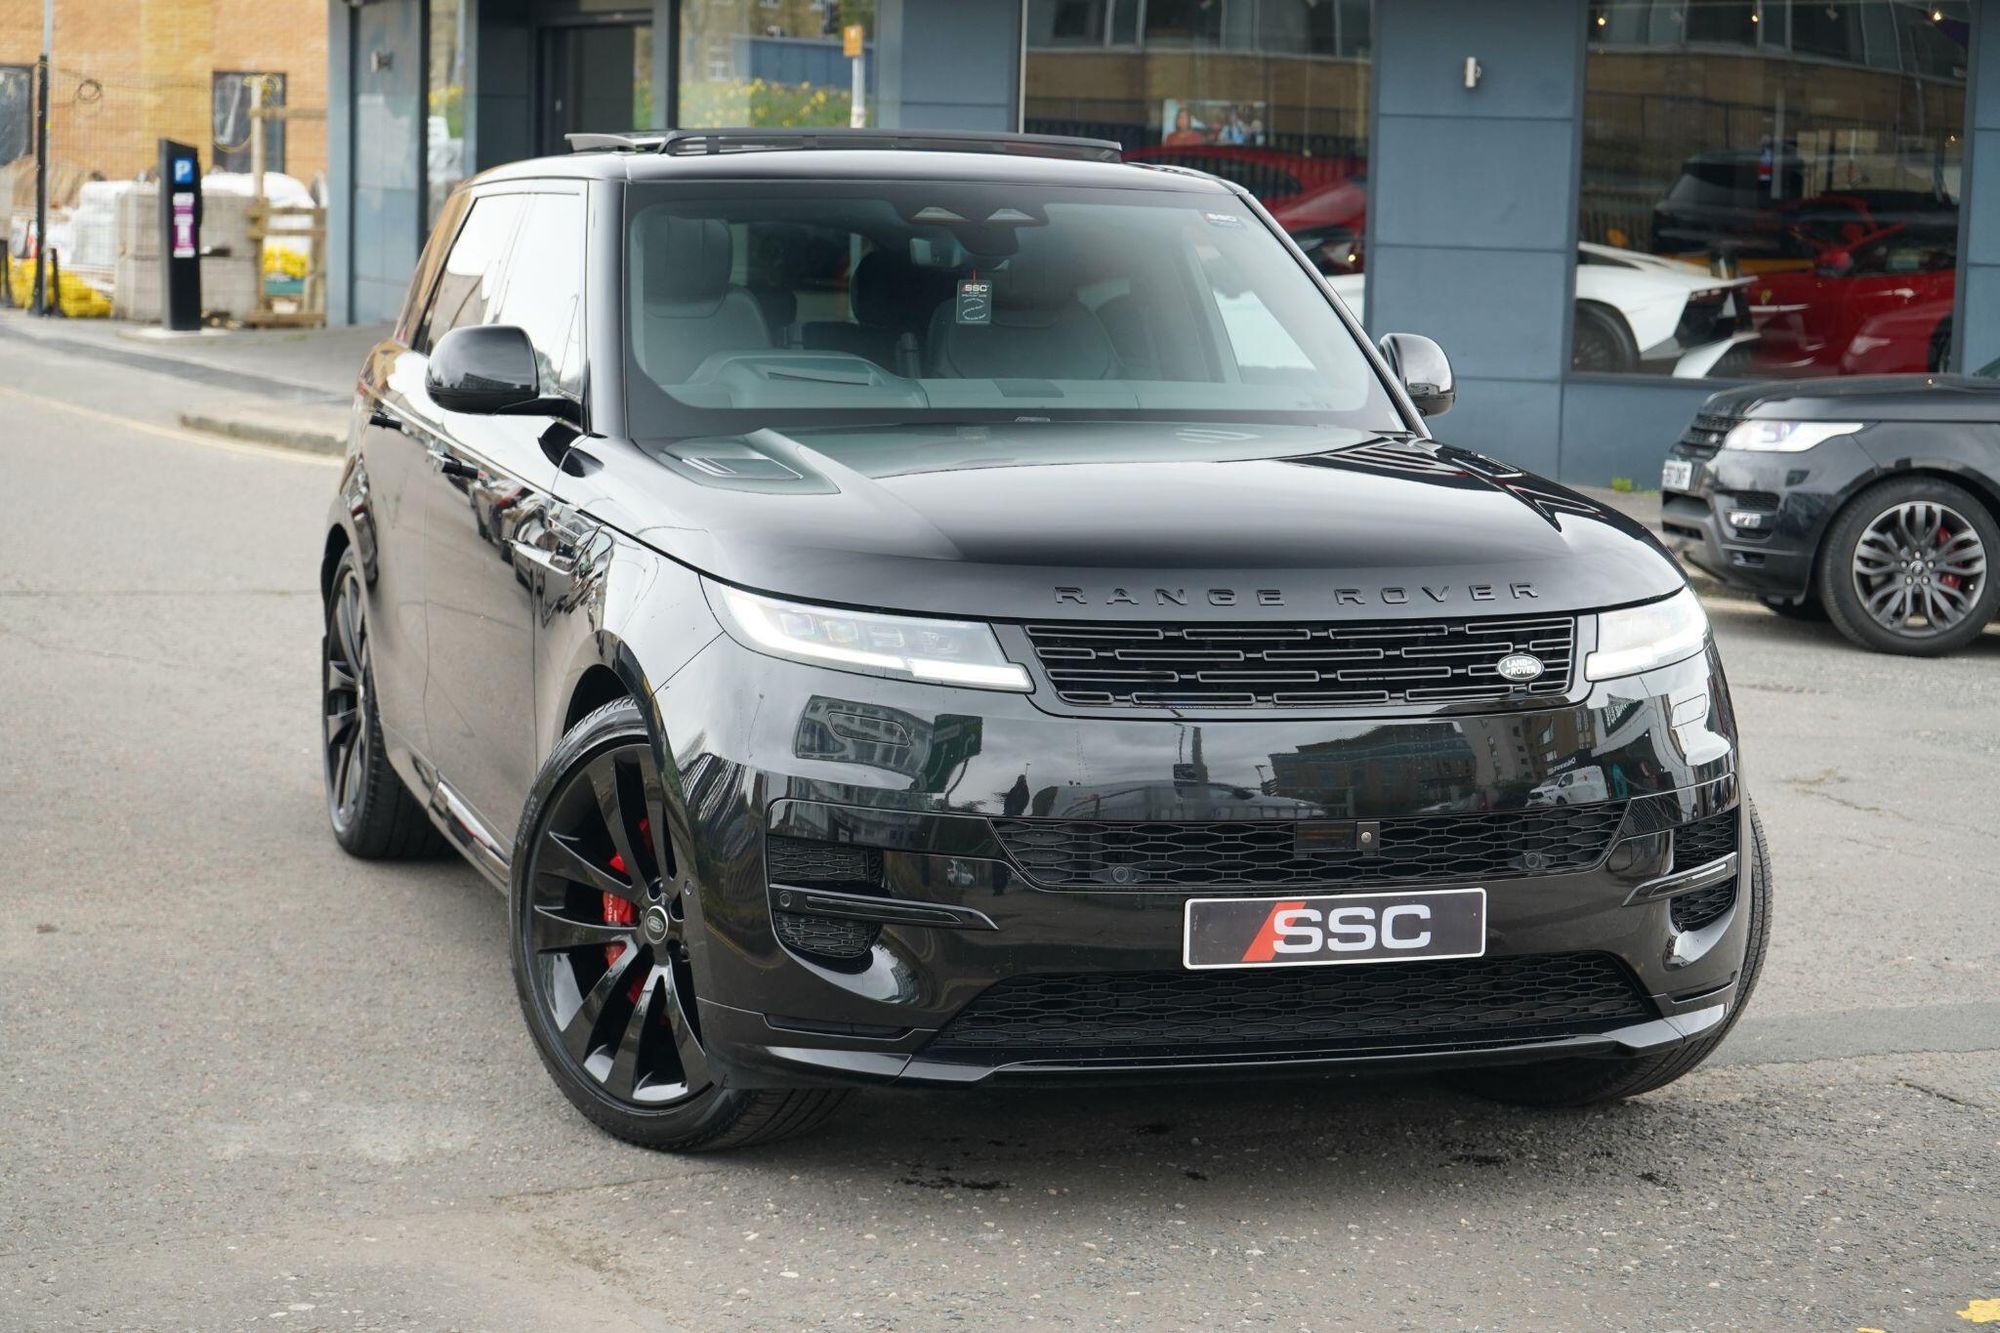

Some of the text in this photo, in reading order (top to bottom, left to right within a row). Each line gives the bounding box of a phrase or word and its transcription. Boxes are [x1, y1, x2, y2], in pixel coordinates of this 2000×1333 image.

[174, 160, 191, 183] P
[1054, 582, 1539, 606] RANGE ROVER
[1506, 659, 1528, 667] LAND
[1510, 665, 1536, 675] ROVER
[1273, 904, 1432, 954] SSC
